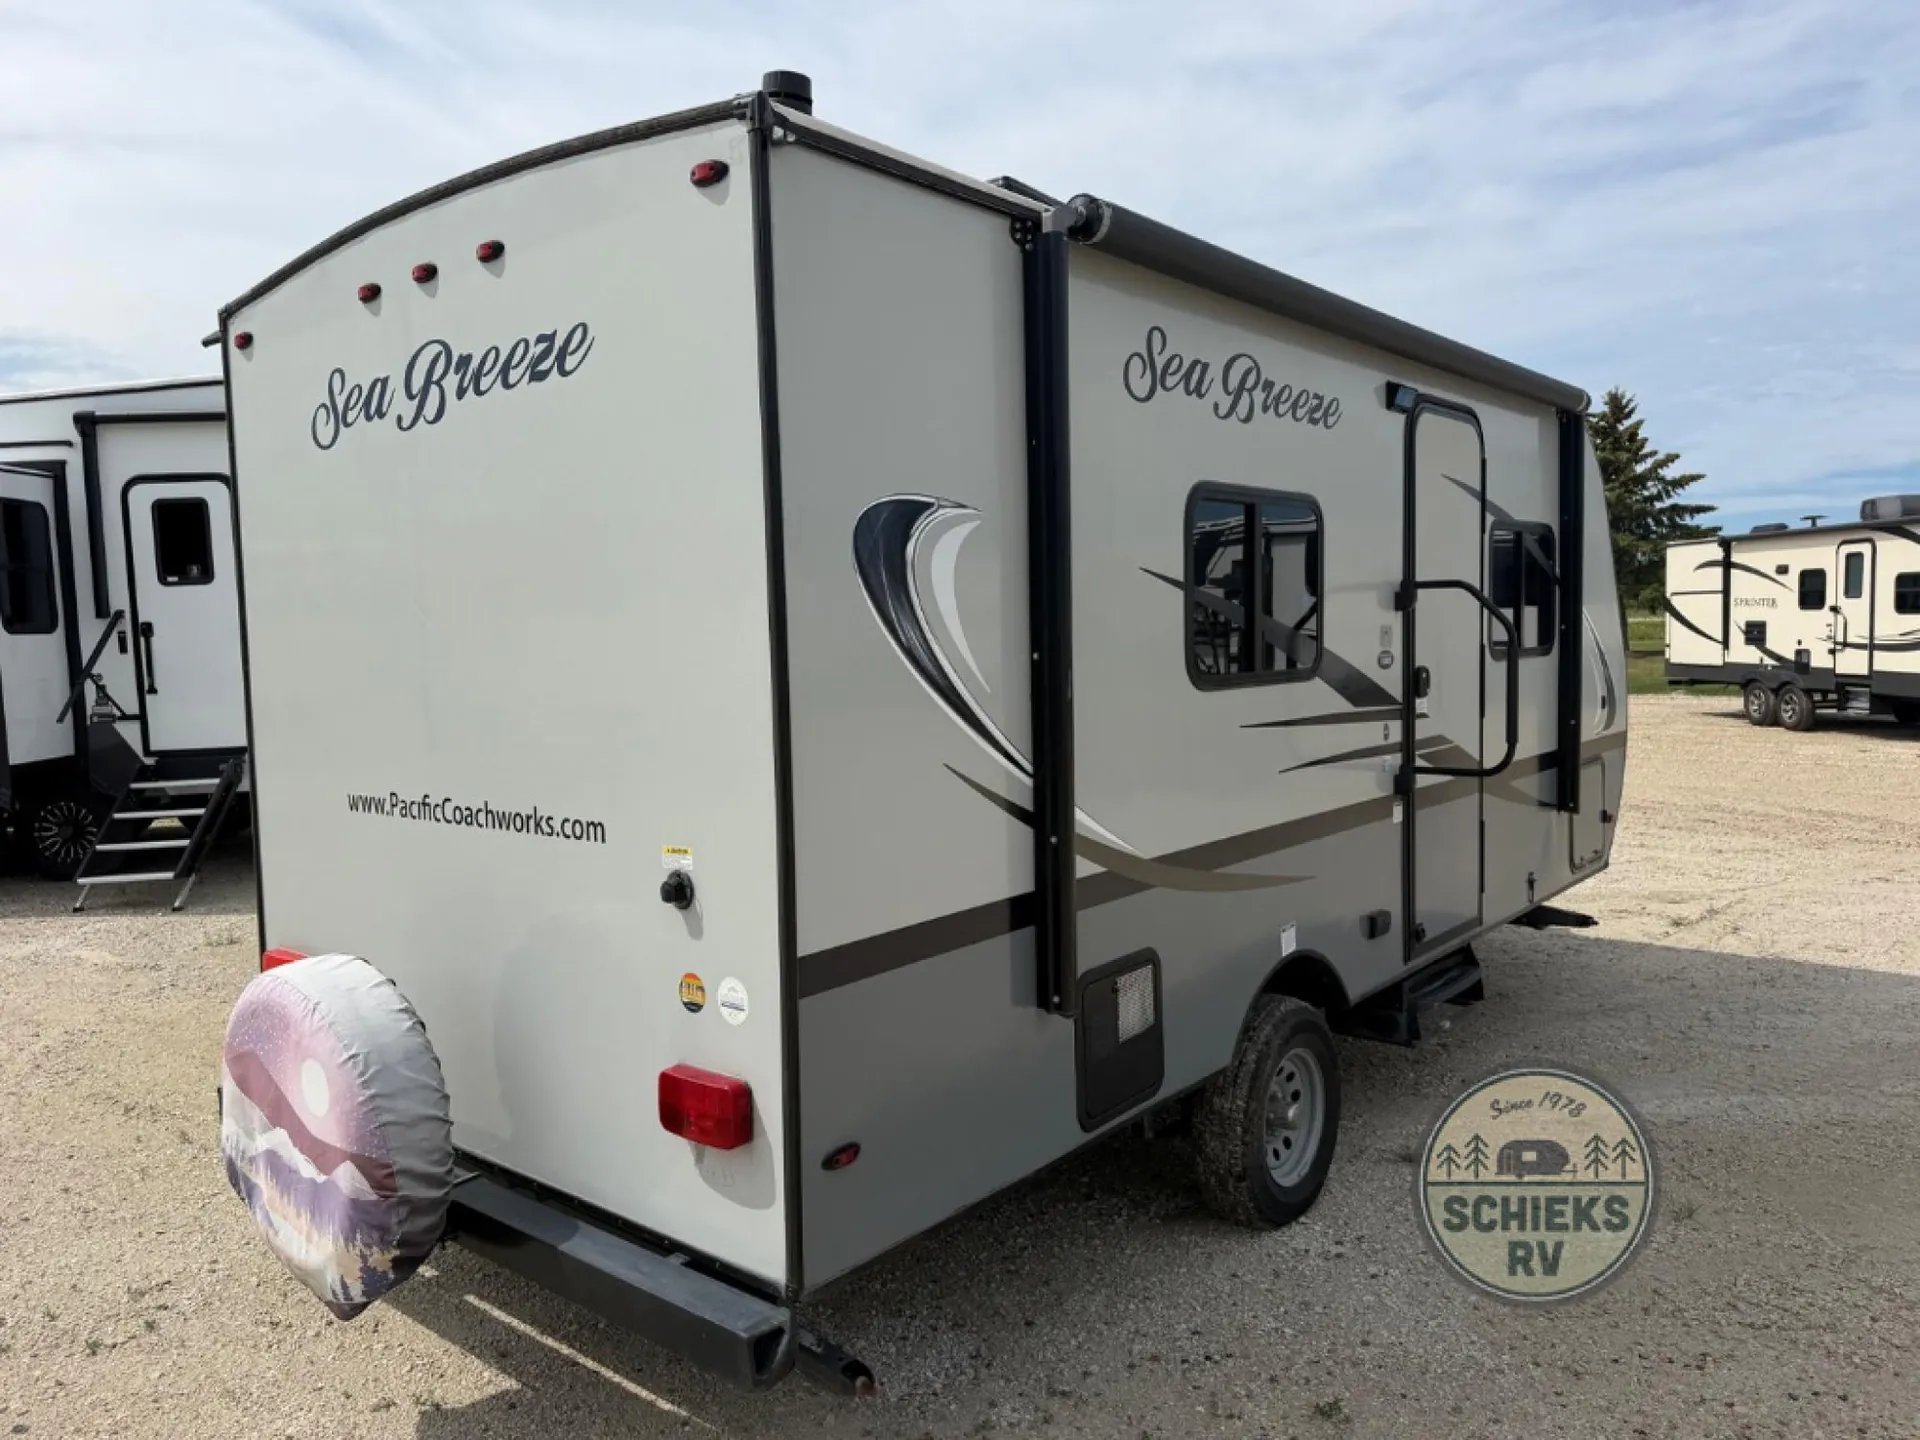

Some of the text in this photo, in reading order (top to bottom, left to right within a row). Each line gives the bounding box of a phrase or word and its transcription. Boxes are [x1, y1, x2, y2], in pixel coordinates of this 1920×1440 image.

[312, 322, 595, 450] Sea Breeze
[1123, 326, 1343, 429] Sea Breeze
[347, 792, 607, 844] www.PacificCoachworks.com
